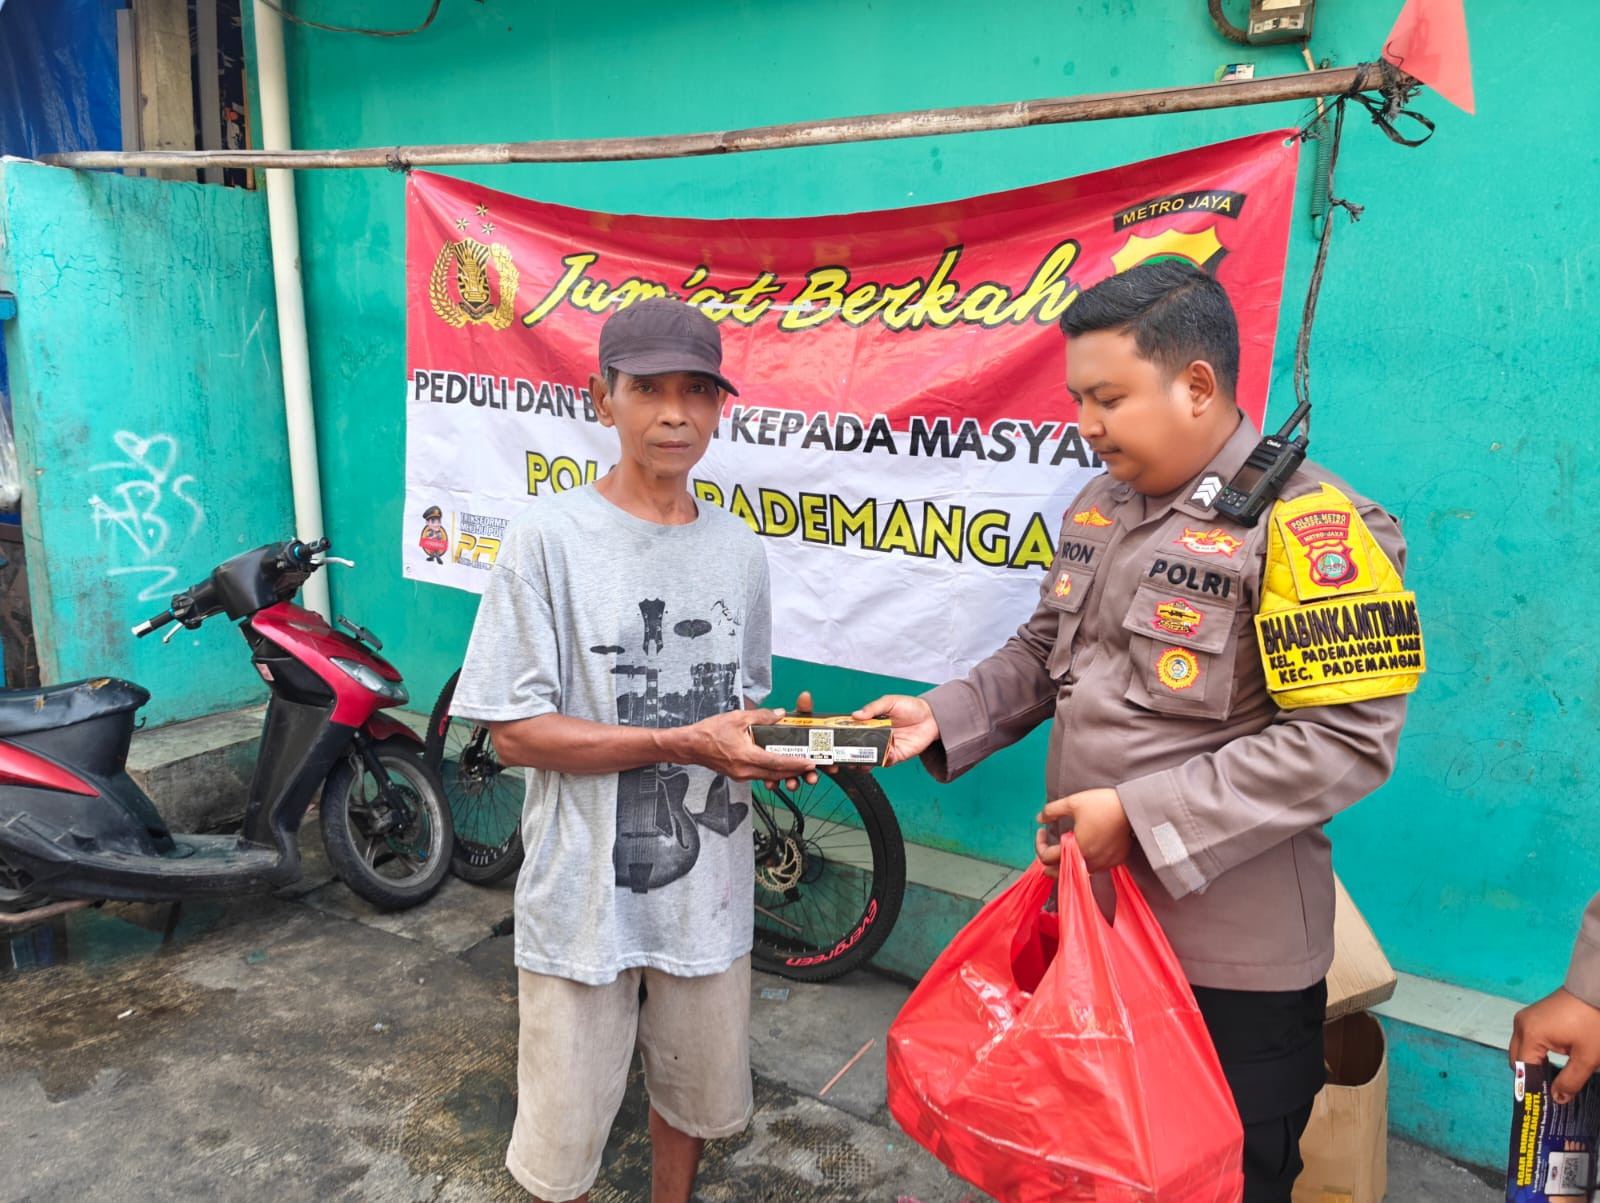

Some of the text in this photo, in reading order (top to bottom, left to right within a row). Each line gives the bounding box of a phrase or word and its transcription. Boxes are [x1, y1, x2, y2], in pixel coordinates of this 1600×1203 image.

[1121, 195, 1232, 225] METRO JAYA
[777, 238, 1082, 331] Berkah
[414, 371, 508, 410] PEDULI
[515, 380, 577, 420] DAN
[730, 406, 898, 456] KEPADA
[692, 477, 1057, 571] PADEMANGA
[1148, 558, 1232, 599] POLRI
[1301, 639, 1393, 665] PADEMANGAN
[1321, 653, 1421, 678] PADEMANGAN
